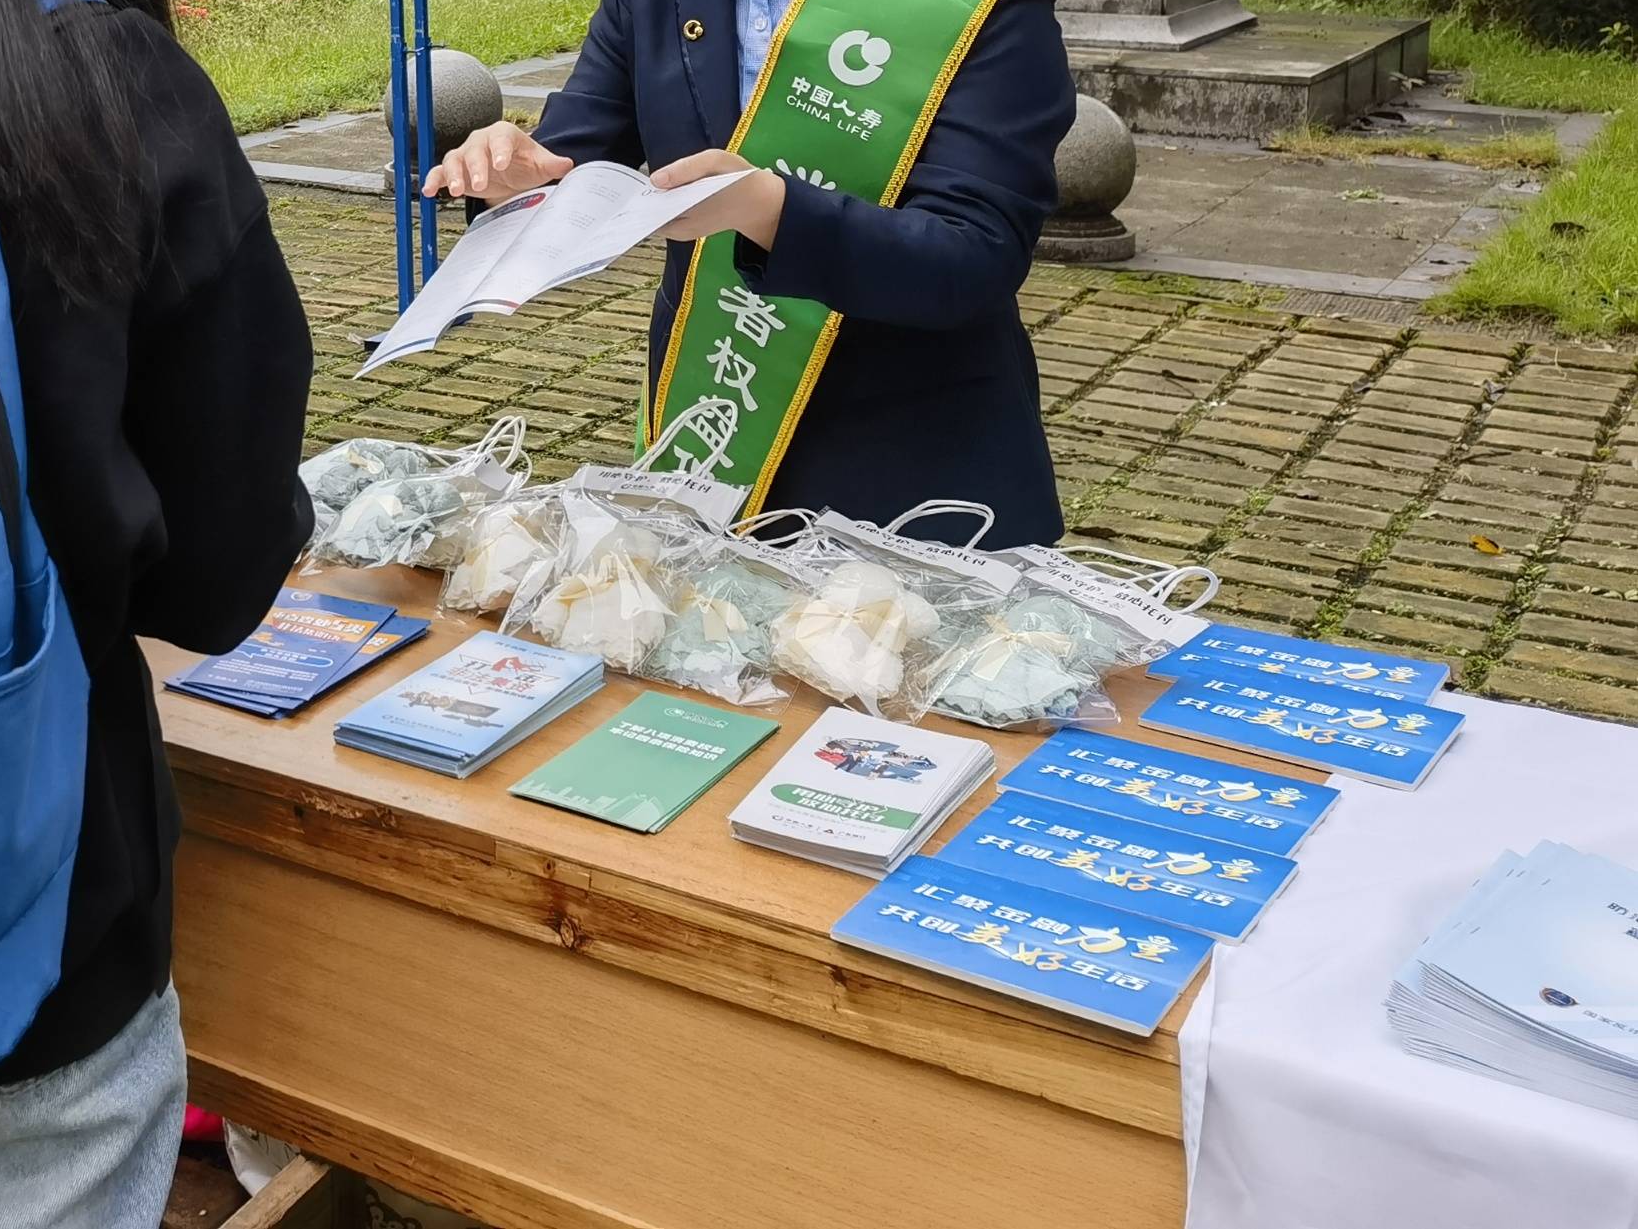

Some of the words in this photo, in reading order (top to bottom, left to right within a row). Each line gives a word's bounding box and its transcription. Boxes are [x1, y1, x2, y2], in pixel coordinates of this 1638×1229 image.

[786, 95, 831, 123] CHINA
[837, 119, 872, 142] LIFE
[791, 76, 883, 129] 中国人寿
[1202, 638, 1422, 684] 汇聚金融力量
[1176, 696, 1412, 758] 共创美好生活
[1203, 679, 1434, 735] 汇聚金融力量
[1039, 763, 1284, 830] 共创美好生活
[1067, 748, 1308, 809] 汇聚金融力量
[976, 833, 1236, 908] 共创美好生活
[1007, 815, 1263, 883] 汇聚金融力量
[877, 903, 1152, 992] 共创美好生活
[913, 882, 1179, 963] 汇聚金融力量
